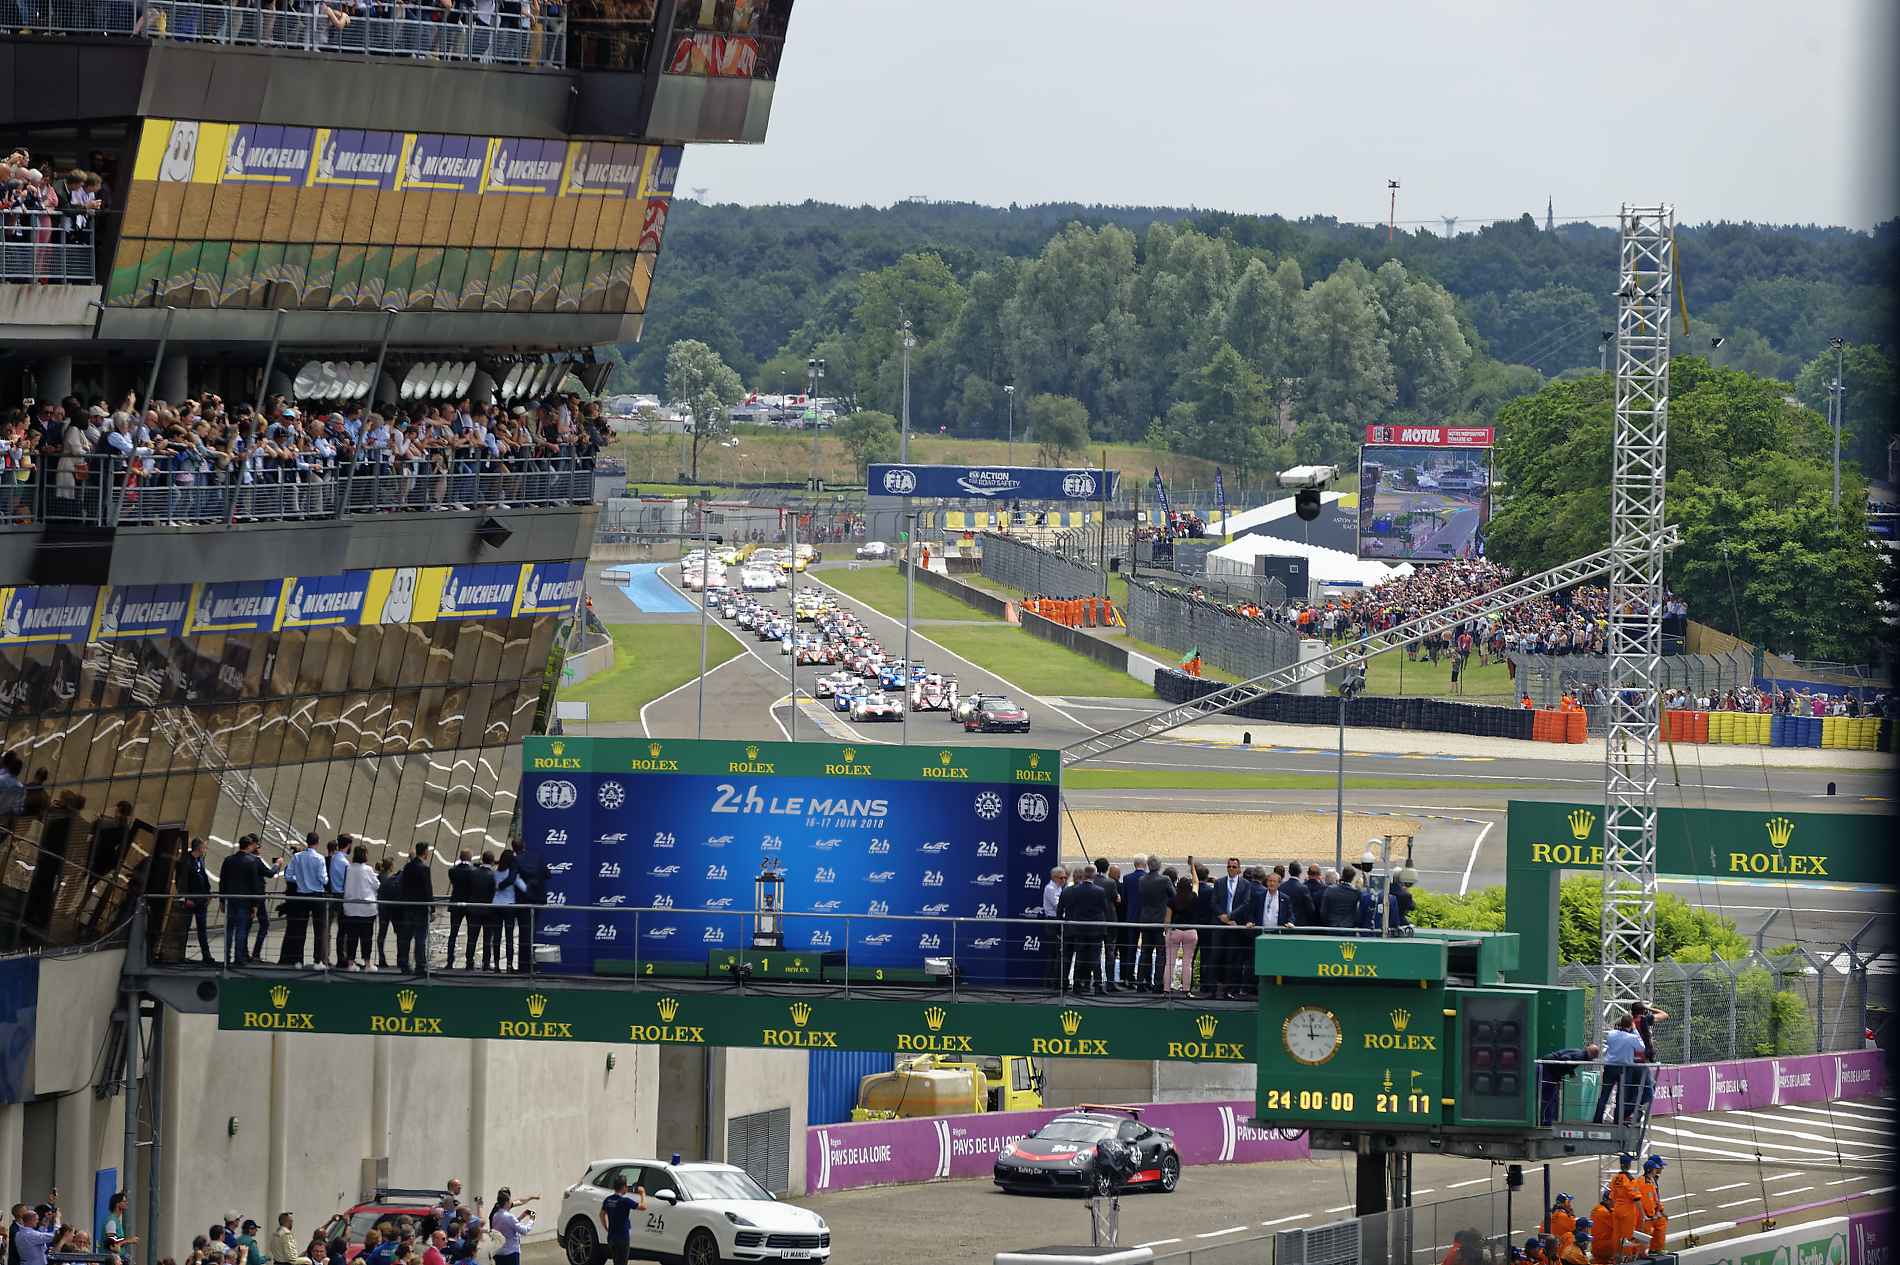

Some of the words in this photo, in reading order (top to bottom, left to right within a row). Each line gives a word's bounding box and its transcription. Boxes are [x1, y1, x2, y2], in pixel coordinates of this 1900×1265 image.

[245, 147, 309, 169] MICHELIN
[336, 151, 397, 173] MICHELIN
[422, 155, 482, 178] MICHELIN
[506, 158, 563, 181] MICHELIN
[586, 162, 640, 184] MICHELIN
[1401, 429, 1440, 443] MOTUL
[979, 472, 1010, 481] ACTION
[302, 591, 363, 613] MICHELIN
[457, 584, 514, 605] MICHELIN
[119, 601, 187, 624] MICHELIN
[212, 596, 277, 618] MICHELIN
[22, 606, 92, 629] MICHELIN
[534, 757, 582, 769] ROLEX
[631, 759, 679, 771] ROLEX
[729, 762, 775, 774] ROLEX
[825, 764, 873, 776] ROLEX
[922, 767, 969, 779] ROLEX
[1015, 769, 1053, 782] ROLEX
[769, 797, 805, 815] LE
[807, 798, 889, 817] MANS
[834, 818, 858, 828] JUIN
[860, 818, 884, 829] 2018
[1729, 852, 1829, 876] ROLEX
[645, 963, 654, 974] 2
[761, 958, 769, 972] 1
[1317, 963, 1378, 977] ROLEX
[875, 969, 883, 980] 3
[243, 1012, 315, 1030] ROLEX
[370, 1015, 444, 1034] ROLEX
[499, 1020, 573, 1038] ROLEX
[629, 1025, 705, 1042] ROLEX
[762, 1029, 839, 1048] ROLEX
[1364, 1033, 1438, 1050] ROLEX
[896, 1034, 974, 1052] ROLEX
[1031, 1038, 1110, 1056] ROLEX
[1168, 1042, 1246, 1060] ROLEX
[1267, 1090, 1355, 1112] 24:00:00
[1376, 1094, 1398, 1113] 21
[1408, 1094, 1430, 1113] 11
[831, 1149, 848, 1166] PAYS
[848, 1148, 859, 1165] DE
[859, 1147, 869, 1164] LA
[869, 1145, 892, 1163] LOIRE
[953, 1138, 974, 1156] PAYS
[975, 1137, 988, 1154] DE
[988, 1137, 1001, 1153] LA
